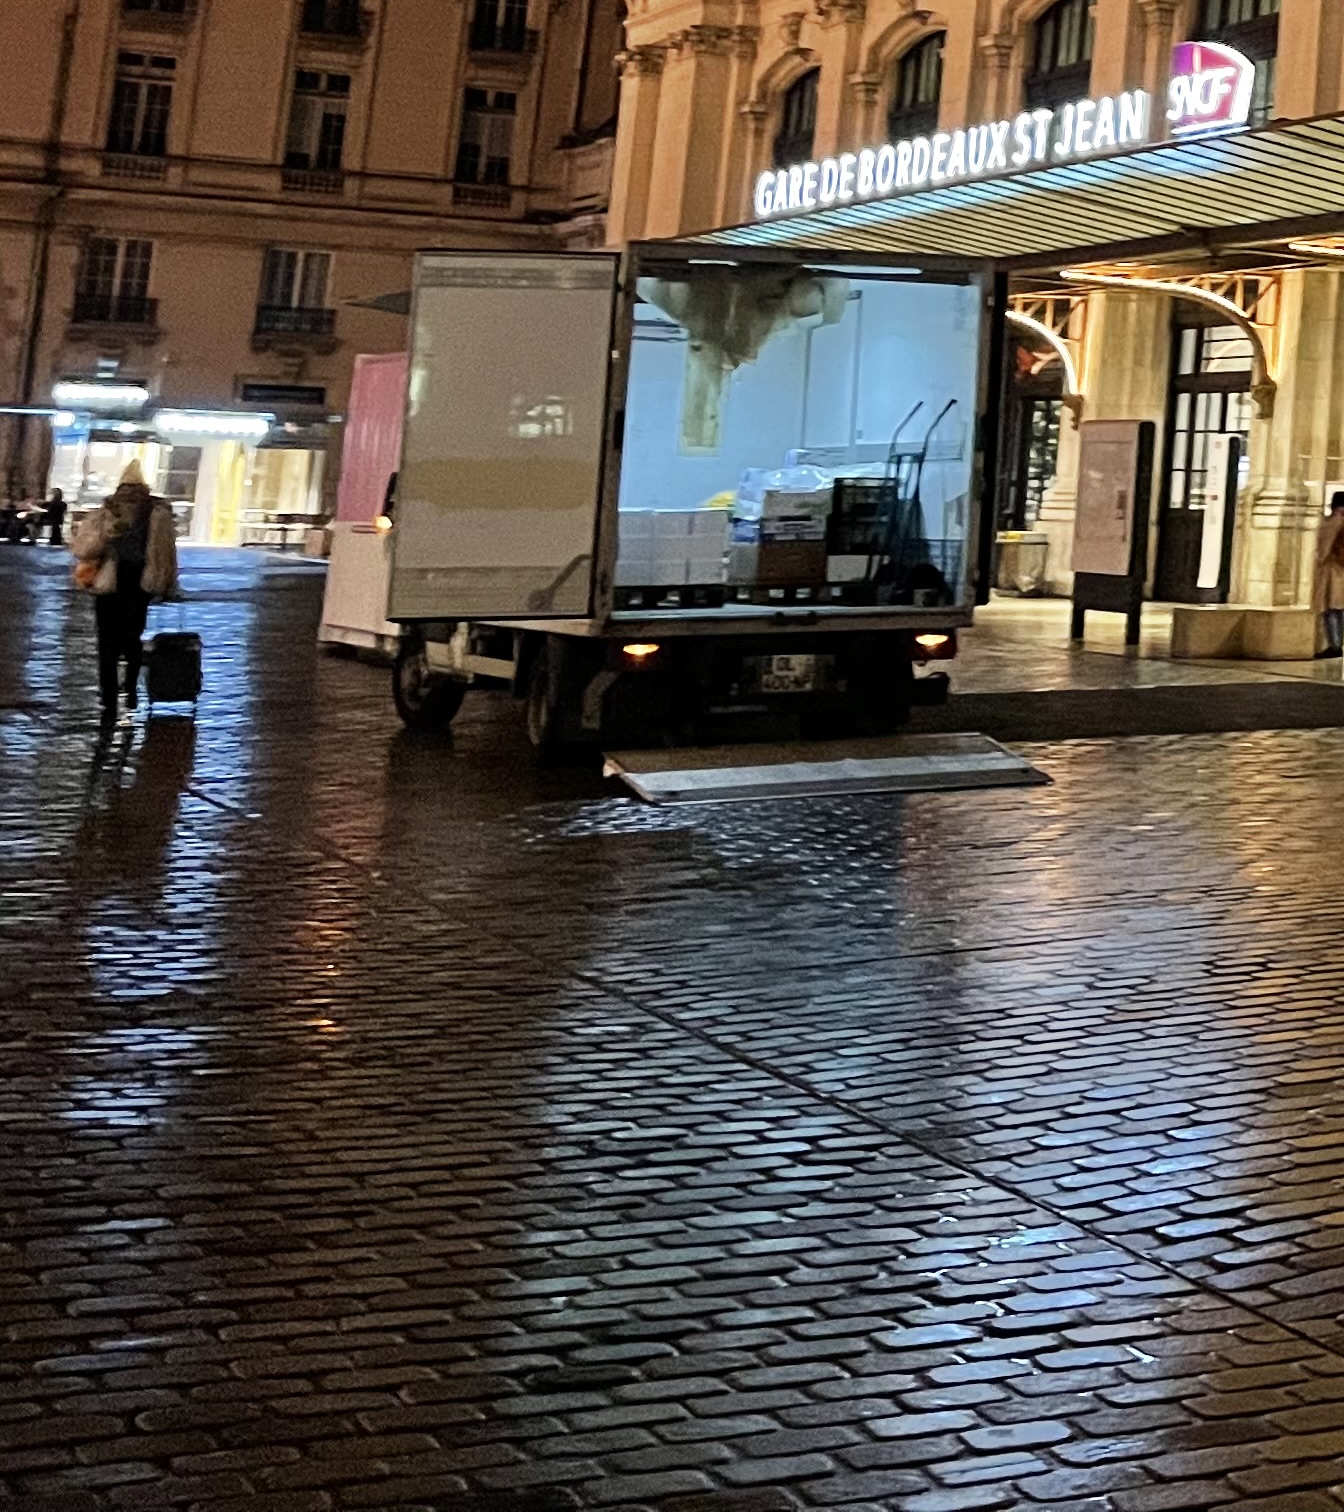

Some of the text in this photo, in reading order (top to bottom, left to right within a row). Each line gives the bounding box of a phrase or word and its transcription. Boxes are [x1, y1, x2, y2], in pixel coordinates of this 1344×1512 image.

[755, 66, 1235, 216] GARE DE BORDEAUX ST JEAN SNCF
